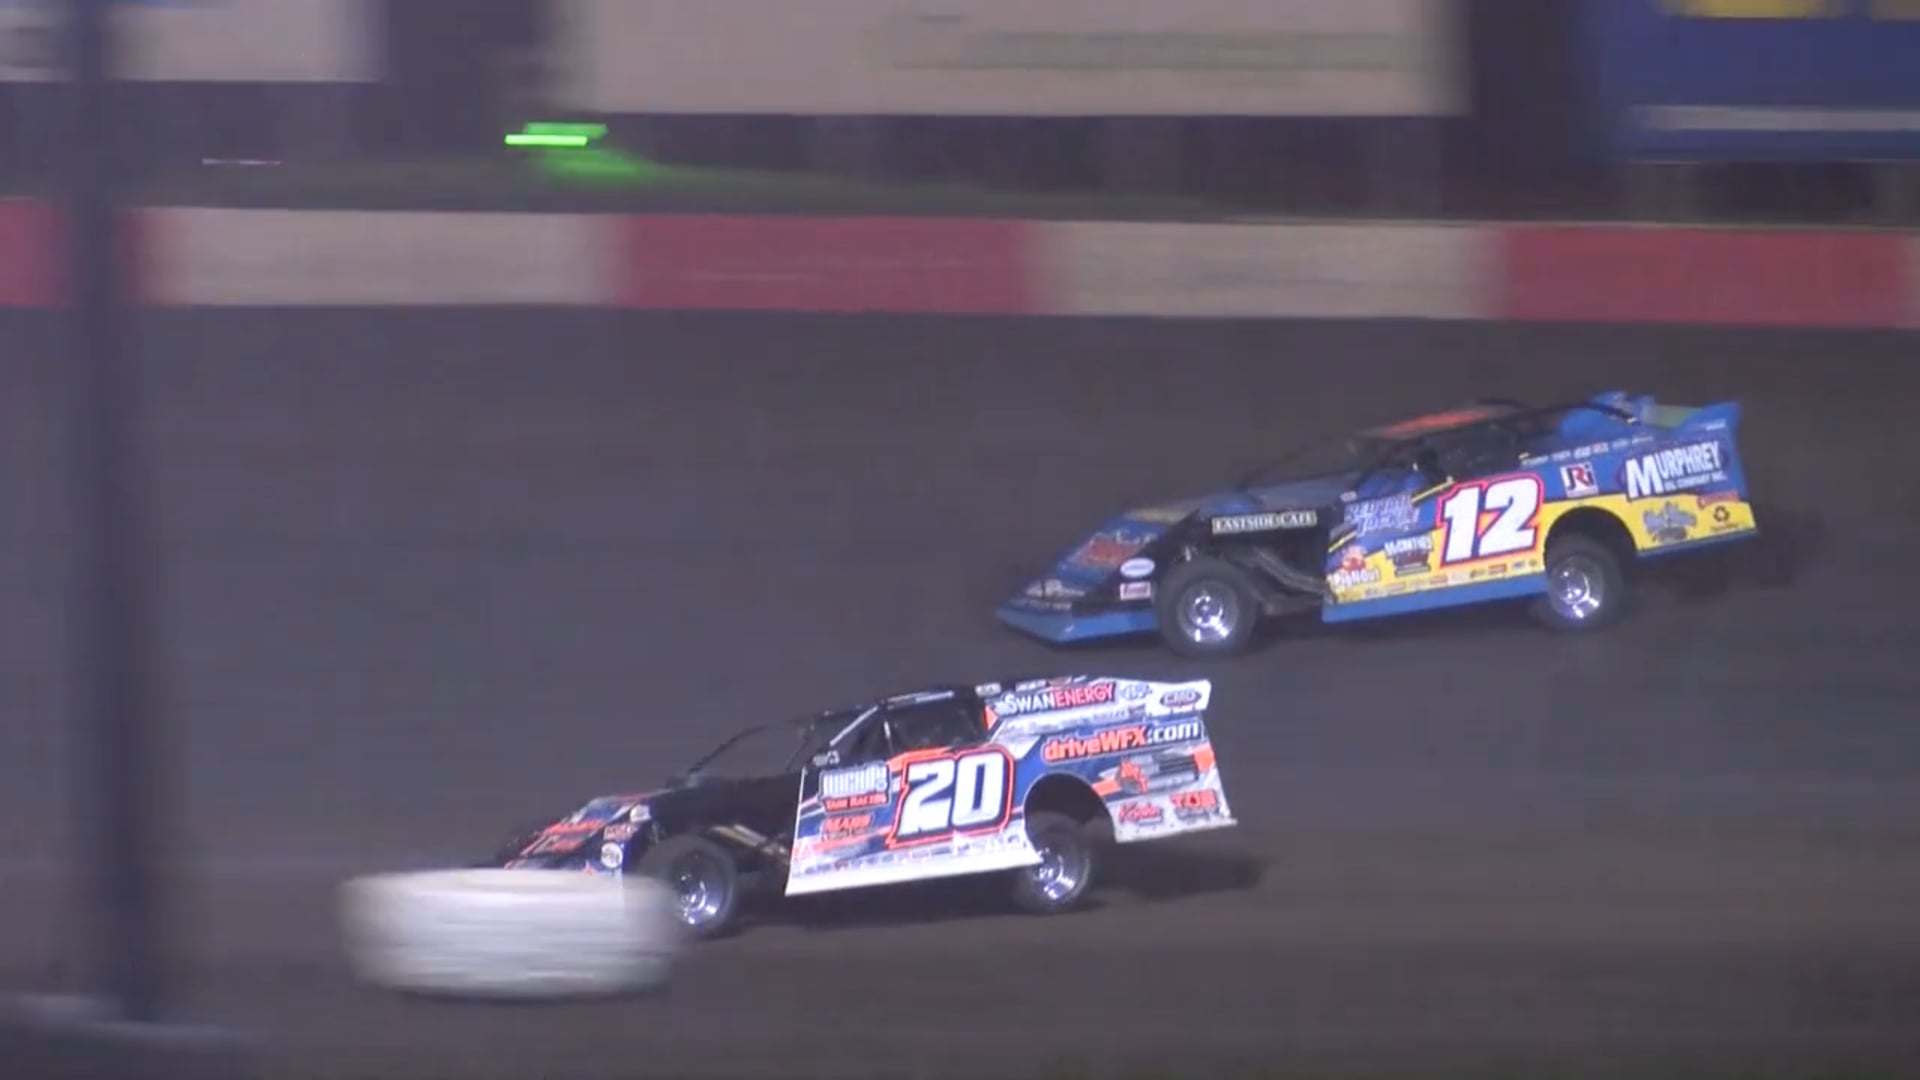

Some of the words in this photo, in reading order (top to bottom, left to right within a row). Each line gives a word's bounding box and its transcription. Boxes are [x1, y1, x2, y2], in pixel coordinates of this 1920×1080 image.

[1626, 441, 1720, 499] MURPHREY
[1215, 515, 1280, 532] EASTSIDE
[1281, 511, 1316, 529] CAFE
[1443, 478, 1540, 563] 12
[899, 751, 1005, 835] 20
